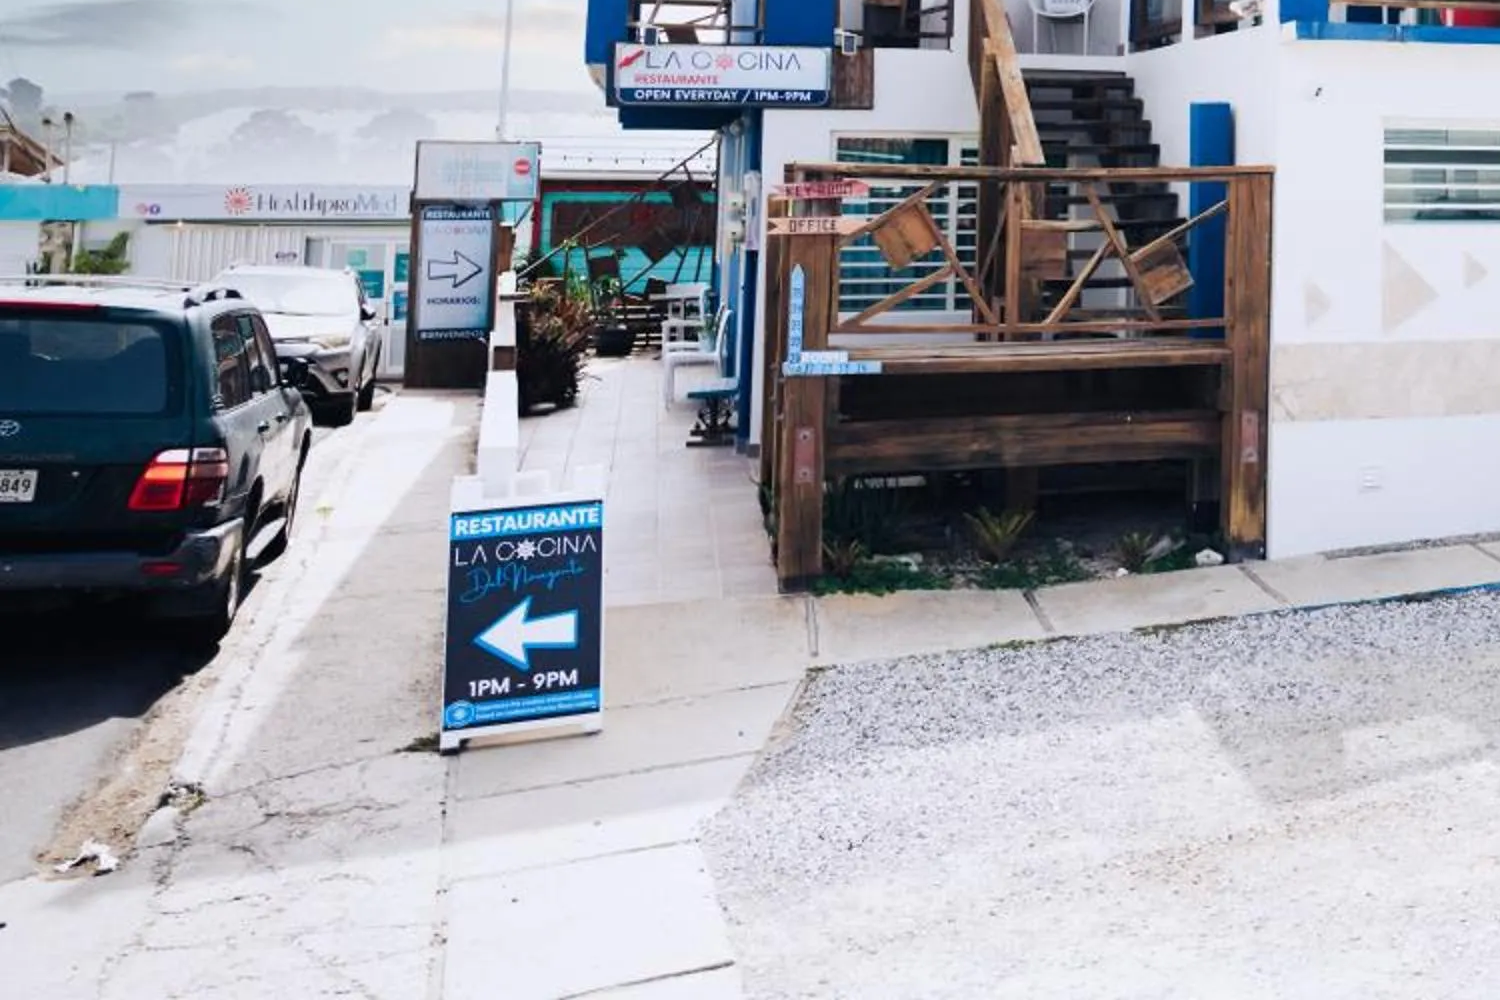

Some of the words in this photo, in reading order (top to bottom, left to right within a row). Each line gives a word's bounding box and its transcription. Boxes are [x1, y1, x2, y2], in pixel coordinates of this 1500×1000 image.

[646, 51, 681, 70] LA
[634, 73, 719, 85] RESTAURANTE
[634, 89, 670, 100] OPEN
[675, 90, 739, 102] EVERYDAY
[789, 219, 837, 232] OFFICE
[455, 507, 599, 536] RESTAURANTE
[454, 545, 487, 567] LA
[468, 678, 510, 697] 1PM
[532, 669, 579, 690] 9PM
